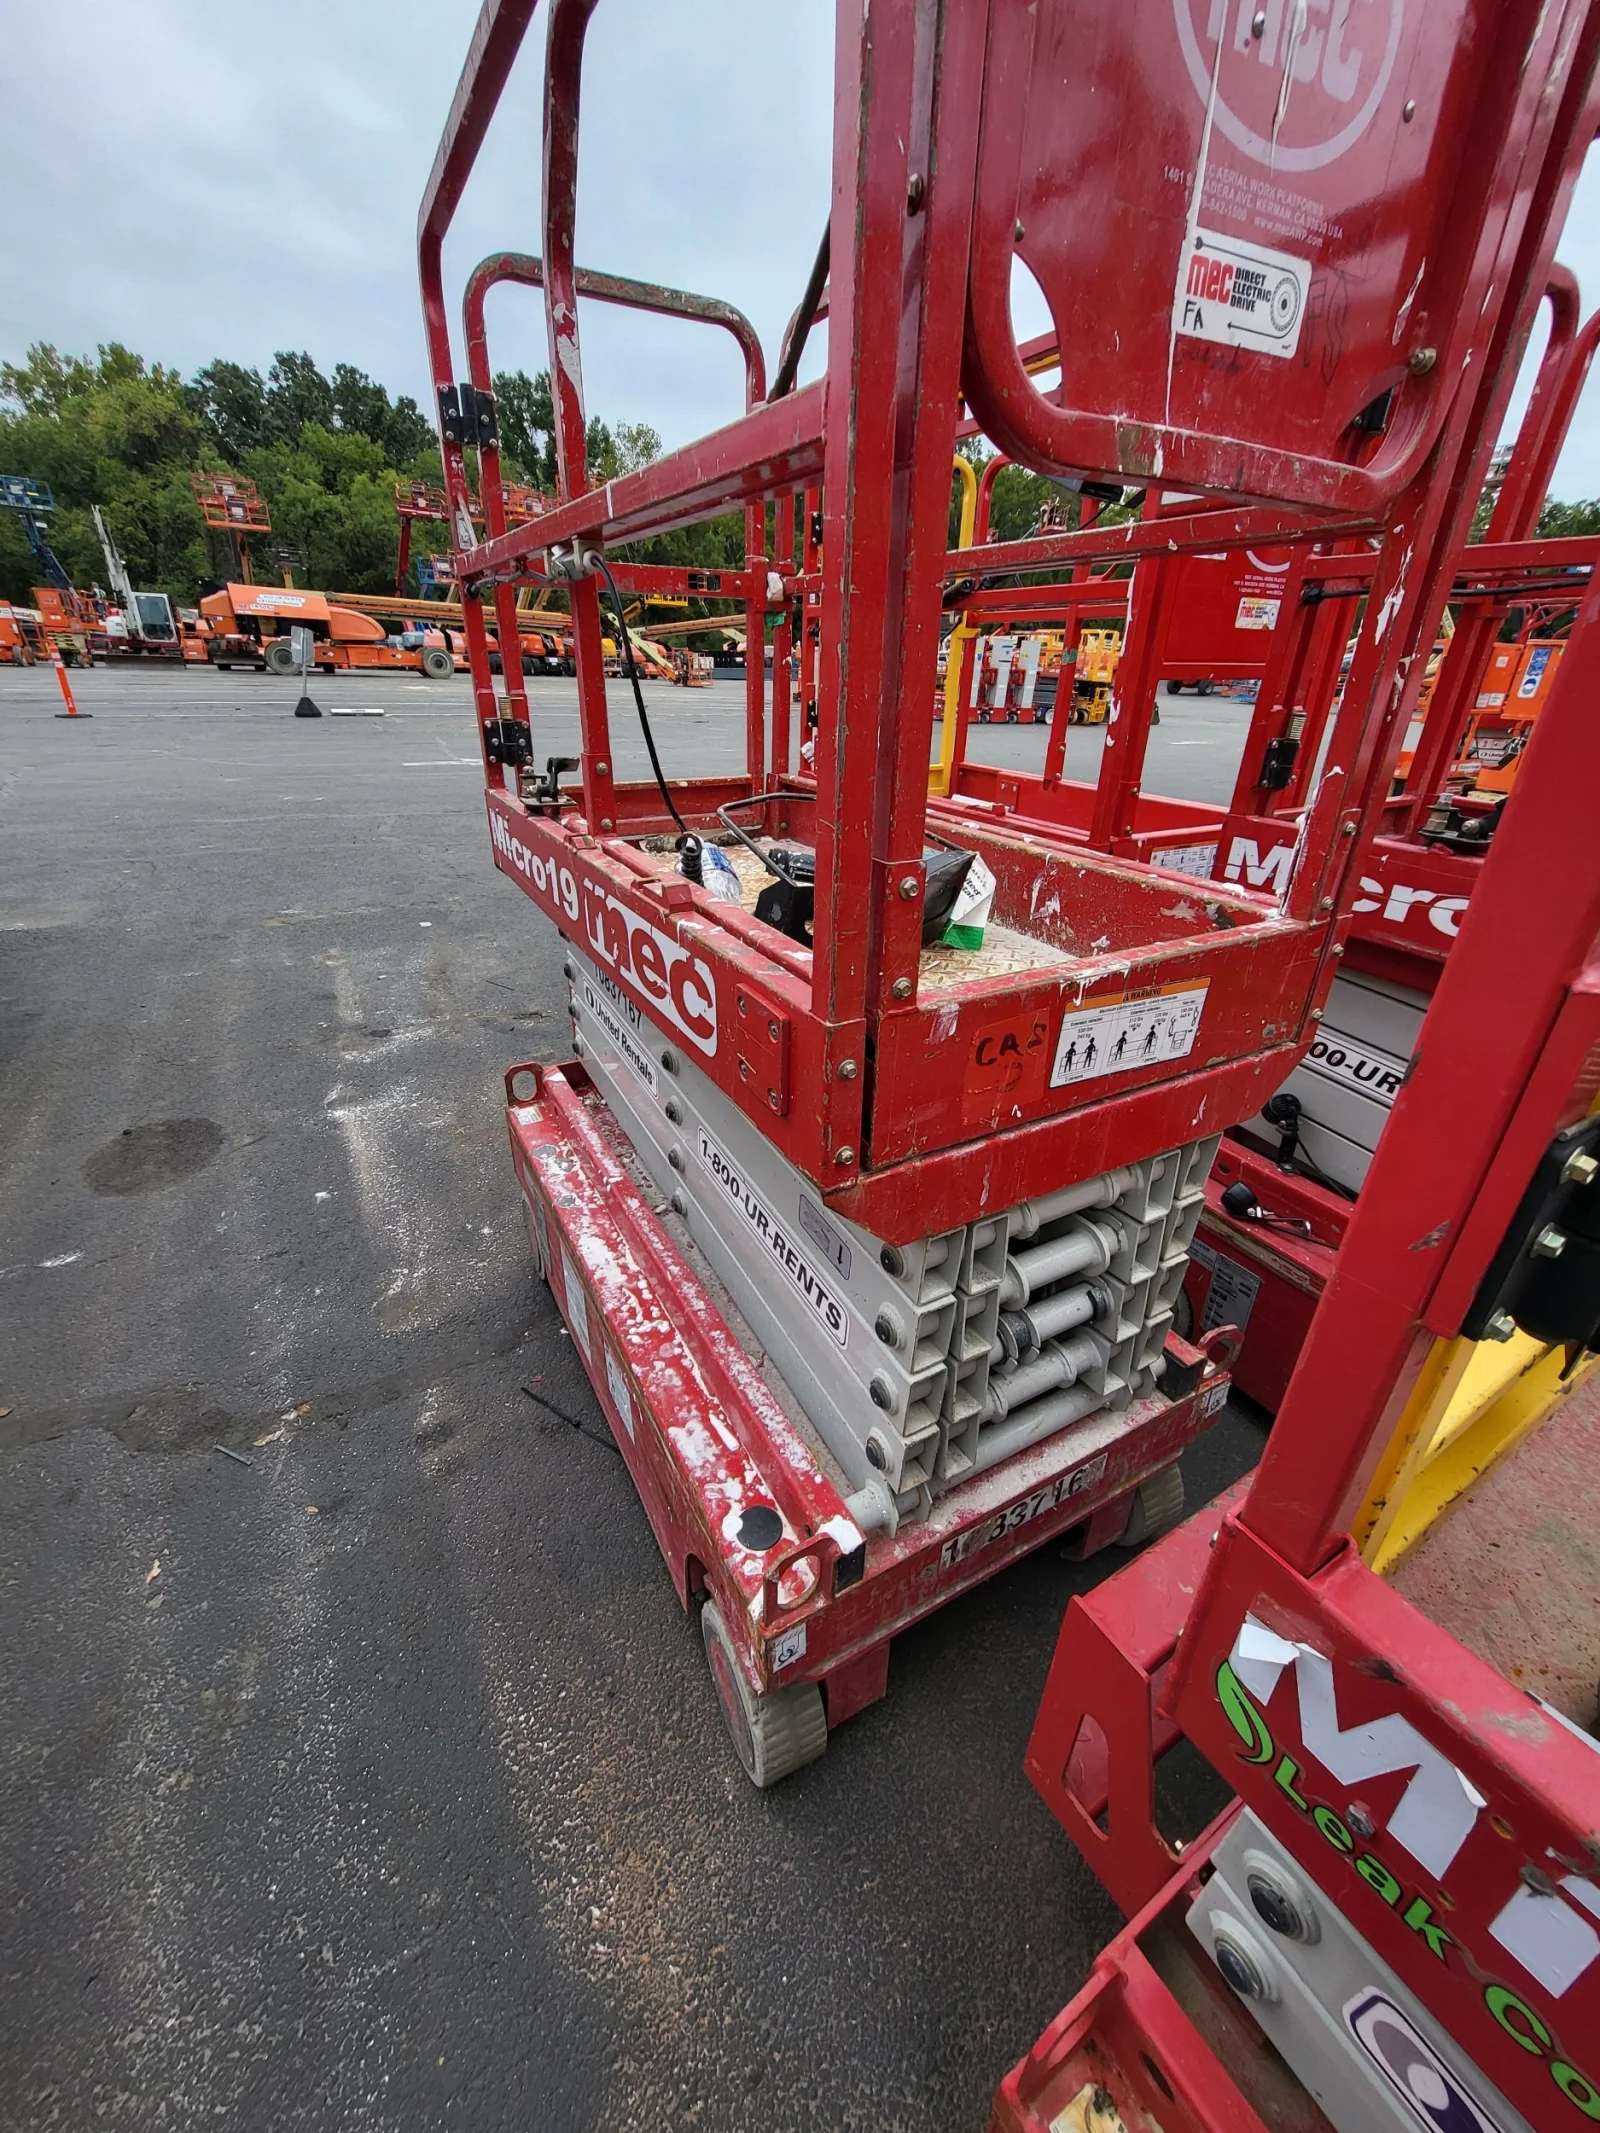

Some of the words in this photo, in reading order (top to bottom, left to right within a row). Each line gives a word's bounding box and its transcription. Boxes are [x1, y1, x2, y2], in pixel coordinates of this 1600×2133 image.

[1204, 180, 1235, 201] ADERA
[1217, 168, 1249, 190] AERIAL
[1250, 178, 1276, 198] WORK
[1277, 187, 1325, 216] PLATFORMS
[1185, 254, 1234, 304] mec
[1235, 267, 1267, 287] DIRECT
[1232, 280, 1272, 303] ELECTRIC
[1230, 294, 1256, 313] DRIVE
[489, 808, 579, 921] Micro19
[1130, 988, 1162, 1000] WARNING
[595, 998, 620, 1043] United
[621, 1032, 653, 1086] Rentals
[701, 1138, 843, 1332] 1-800-UR-RENTS
